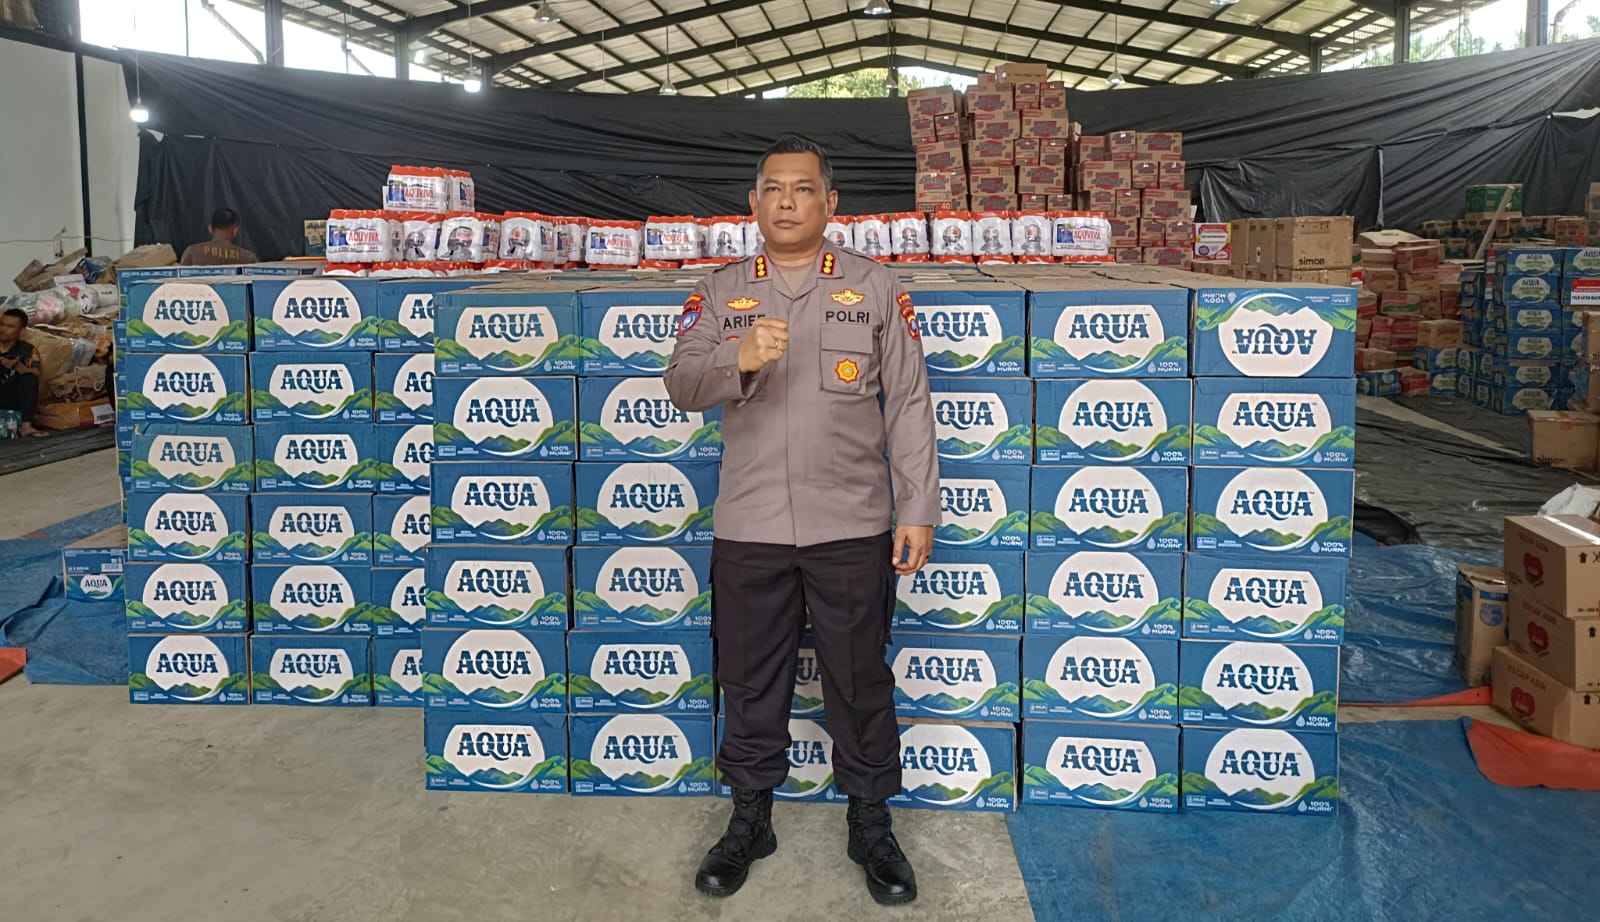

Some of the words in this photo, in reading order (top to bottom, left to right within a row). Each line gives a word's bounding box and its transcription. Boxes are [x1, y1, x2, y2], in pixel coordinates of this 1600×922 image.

[1299, 256, 1325, 265] simon
[154, 299, 217, 324] AQUA
[285, 297, 349, 322] AQUA
[826, 310, 870, 324] POLRI
[470, 314, 544, 342] AQUA
[917, 312, 989, 342] AQUA
[1069, 313, 1149, 344] AQUA
[1233, 323, 1317, 355] AQUA
[154, 372, 215, 396] AQUA
[281, 369, 343, 394] AQUA
[404, 372, 432, 392] AQ
[466, 398, 540, 427] AQUA
[614, 399, 689, 428] AQUA
[1072, 401, 1153, 432] AQUA
[1233, 401, 1316, 432] AQUA
[160, 442, 224, 466] AQUA
[286, 439, 347, 464] AQUA
[404, 442, 434, 464] AQ
[465, 482, 538, 511] AQUA
[610, 483, 684, 512] AQUA
[1069, 487, 1149, 518] AQUA
[1231, 490, 1313, 521] AQUA
[156, 510, 216, 535] AQUA
[280, 513, 342, 536] AQUA
[85, 580, 107, 588] AQUA
[154, 581, 217, 605] AQUA
[281, 583, 343, 607] AQUA
[457, 568, 531, 597] AQUA
[609, 567, 684, 597] AQUA
[910, 570, 987, 600] AQUA
[1064, 572, 1144, 602] AQUA
[1224, 577, 1307, 608] AQUA
[156, 653, 218, 677] AQUA
[280, 653, 342, 677] AQUA
[456, 650, 531, 679] AQUA
[604, 650, 678, 679] AQUA
[905, 656, 982, 686] AQUA
[1060, 656, 1140, 687] AQUA
[1217, 664, 1299, 694] AQUA
[457, 732, 531, 760] AQUA
[604, 735, 678, 763] AQUA
[902, 745, 977, 775] AQUA
[1061, 745, 1141, 776] AQUA
[1220, 750, 1300, 780] AQUA
